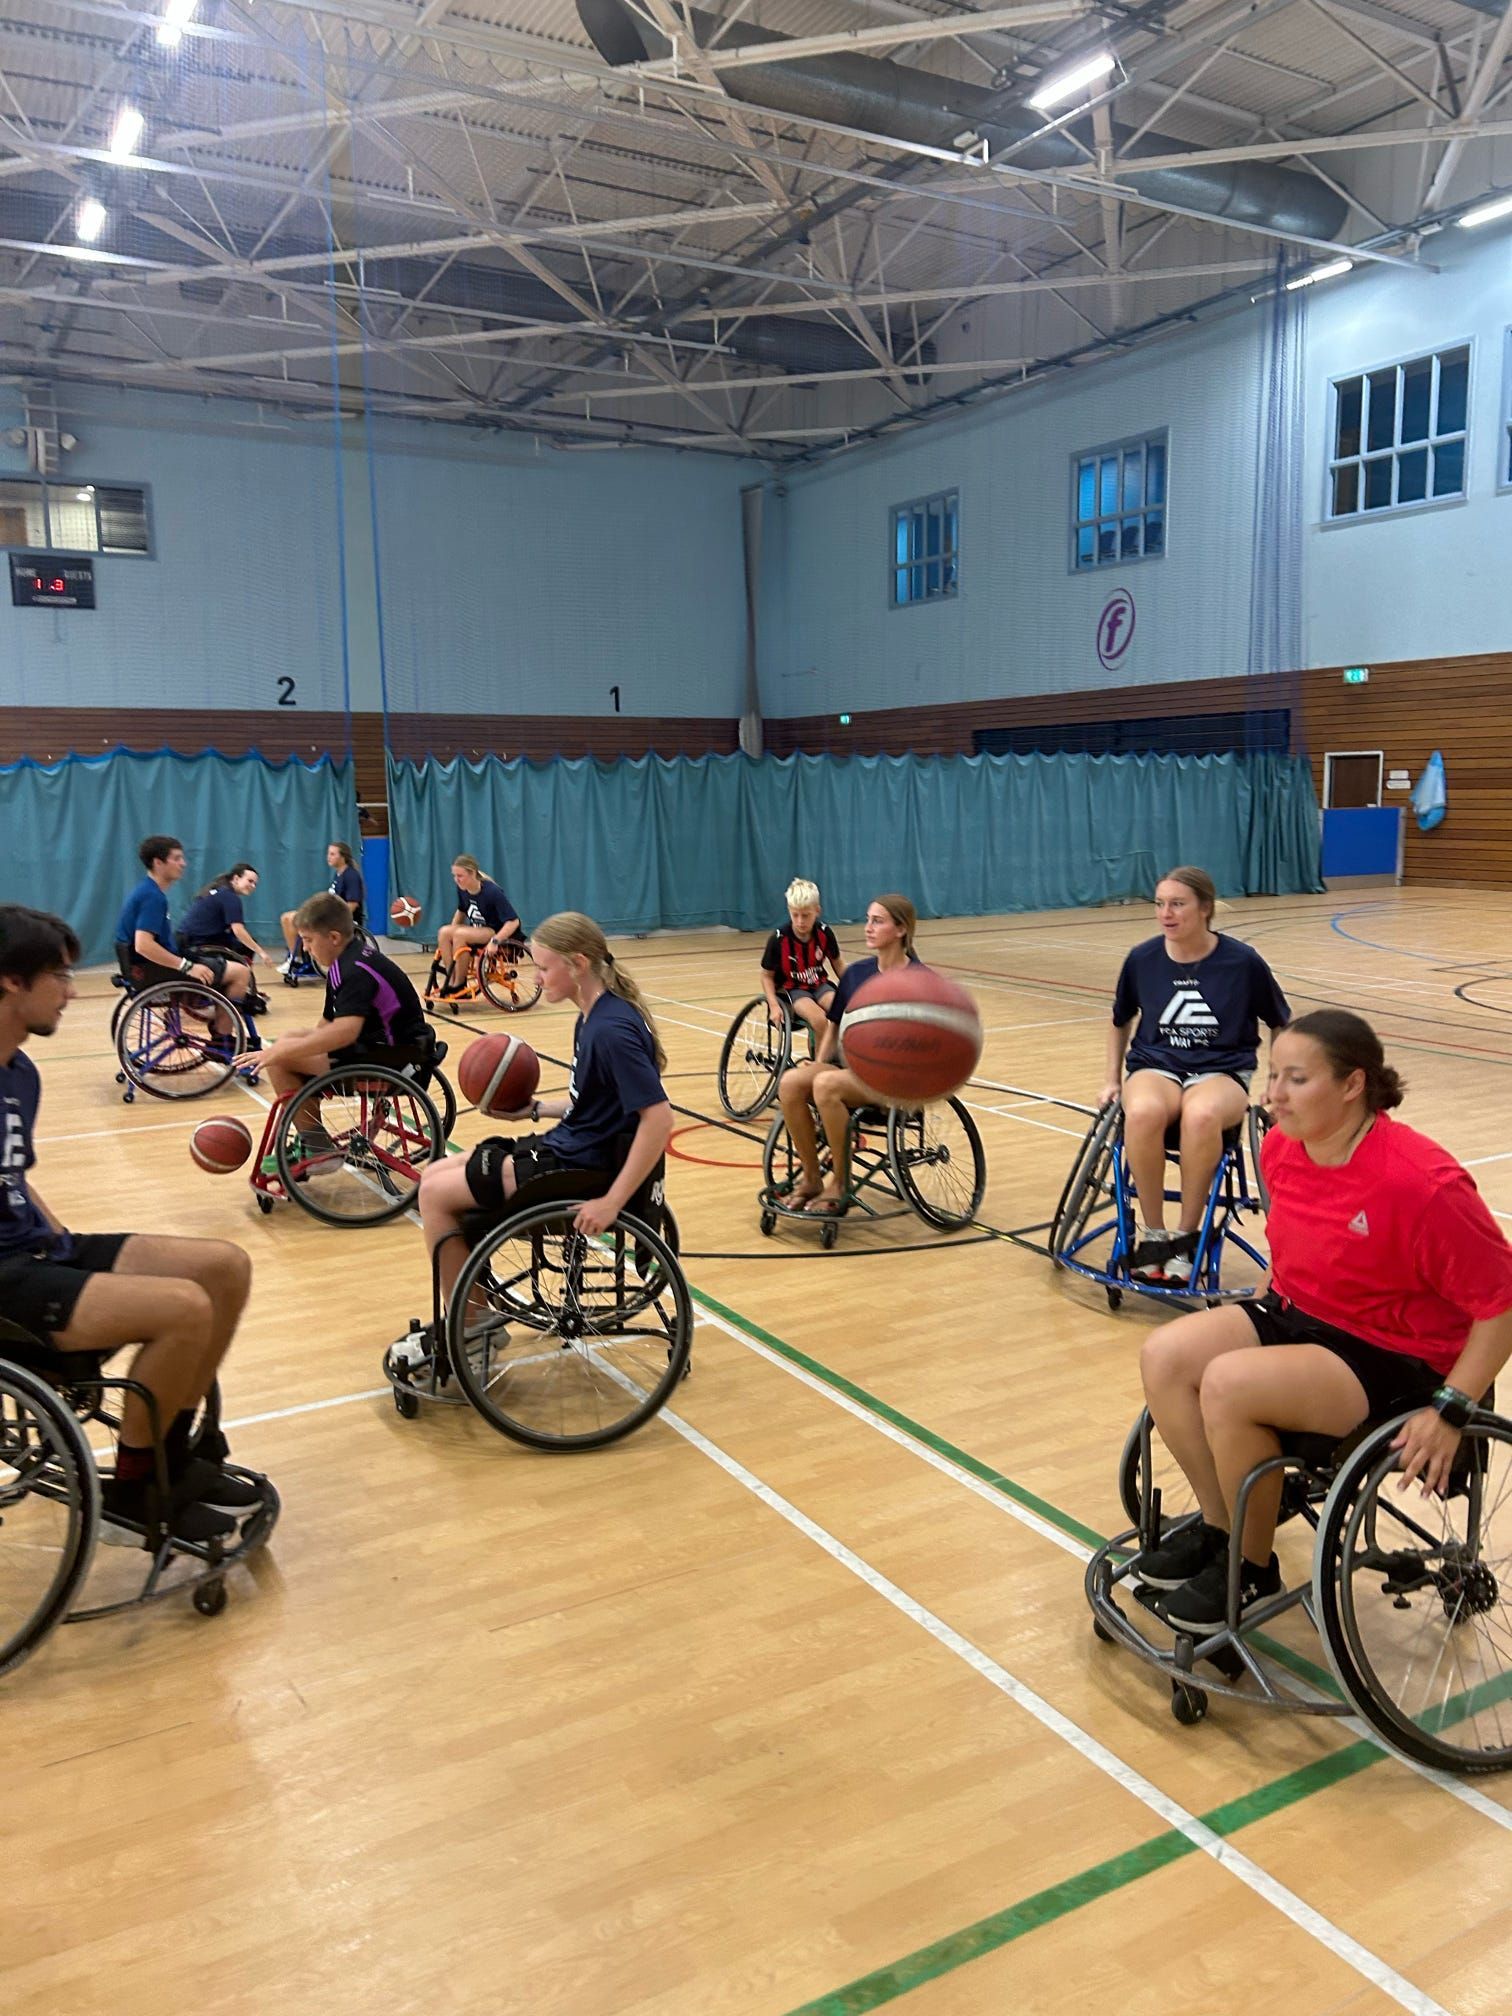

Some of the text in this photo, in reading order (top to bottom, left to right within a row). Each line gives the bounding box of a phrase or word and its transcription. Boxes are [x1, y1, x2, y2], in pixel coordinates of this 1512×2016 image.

[277, 676, 296, 705] 2
[609, 685, 620, 712] 1
[1179, 1027, 1219, 1038] SPORTS
